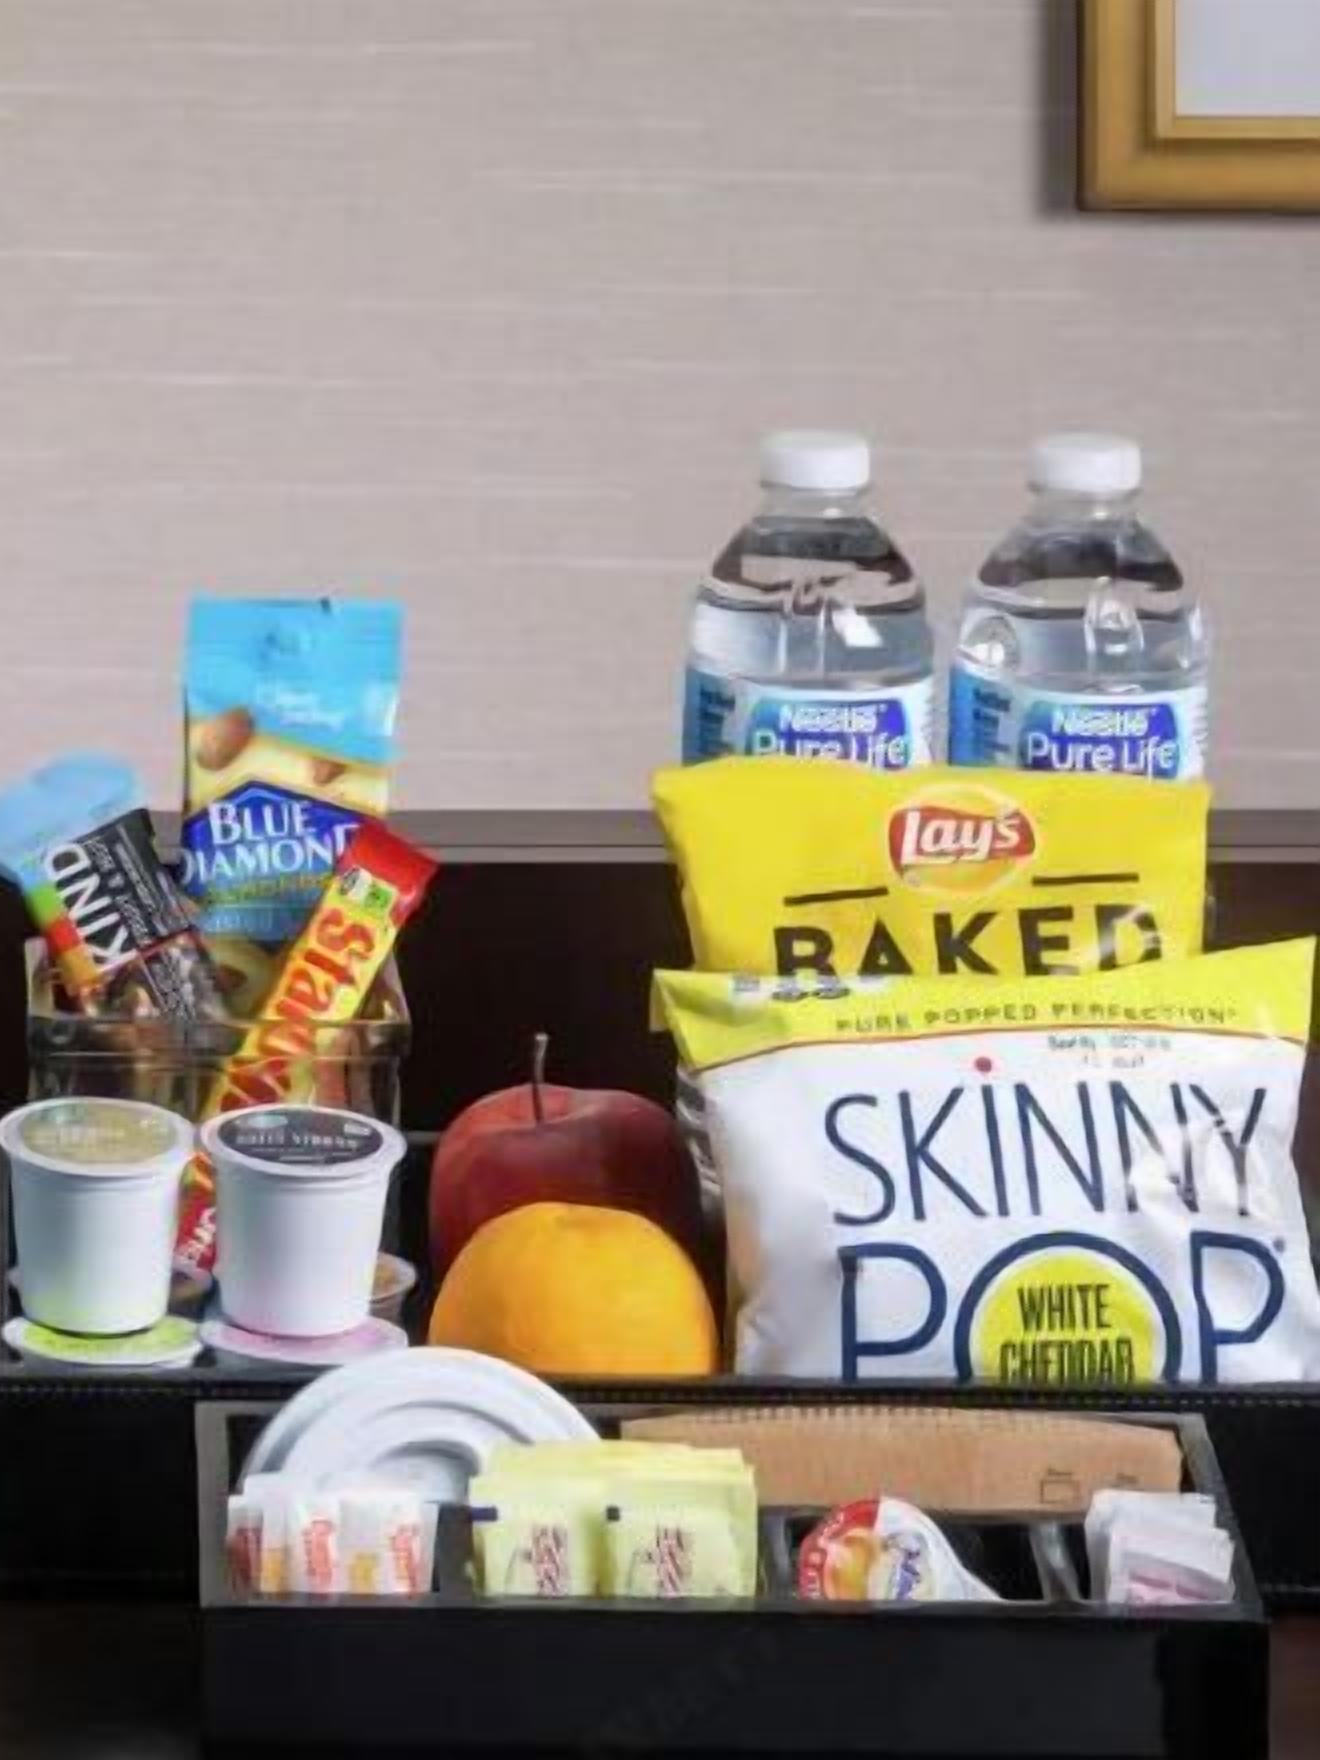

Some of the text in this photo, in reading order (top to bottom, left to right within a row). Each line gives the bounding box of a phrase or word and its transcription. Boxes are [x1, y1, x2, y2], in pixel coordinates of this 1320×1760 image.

[1027, 731, 1177, 783] Pure Life
[208, 801, 318, 845] BLUE
[900, 805, 1022, 865] Lay's
[44, 843, 138, 973] KIND
[773, 904, 1162, 977] BAKED
[836, 1013, 911, 1034] PURE
[924, 1002, 1037, 1025] POPPED
[838, 1230, 1285, 1383] POP
[1017, 1282, 1112, 1334] WHITE
[998, 1337, 1134, 1384] CHEDDAR
